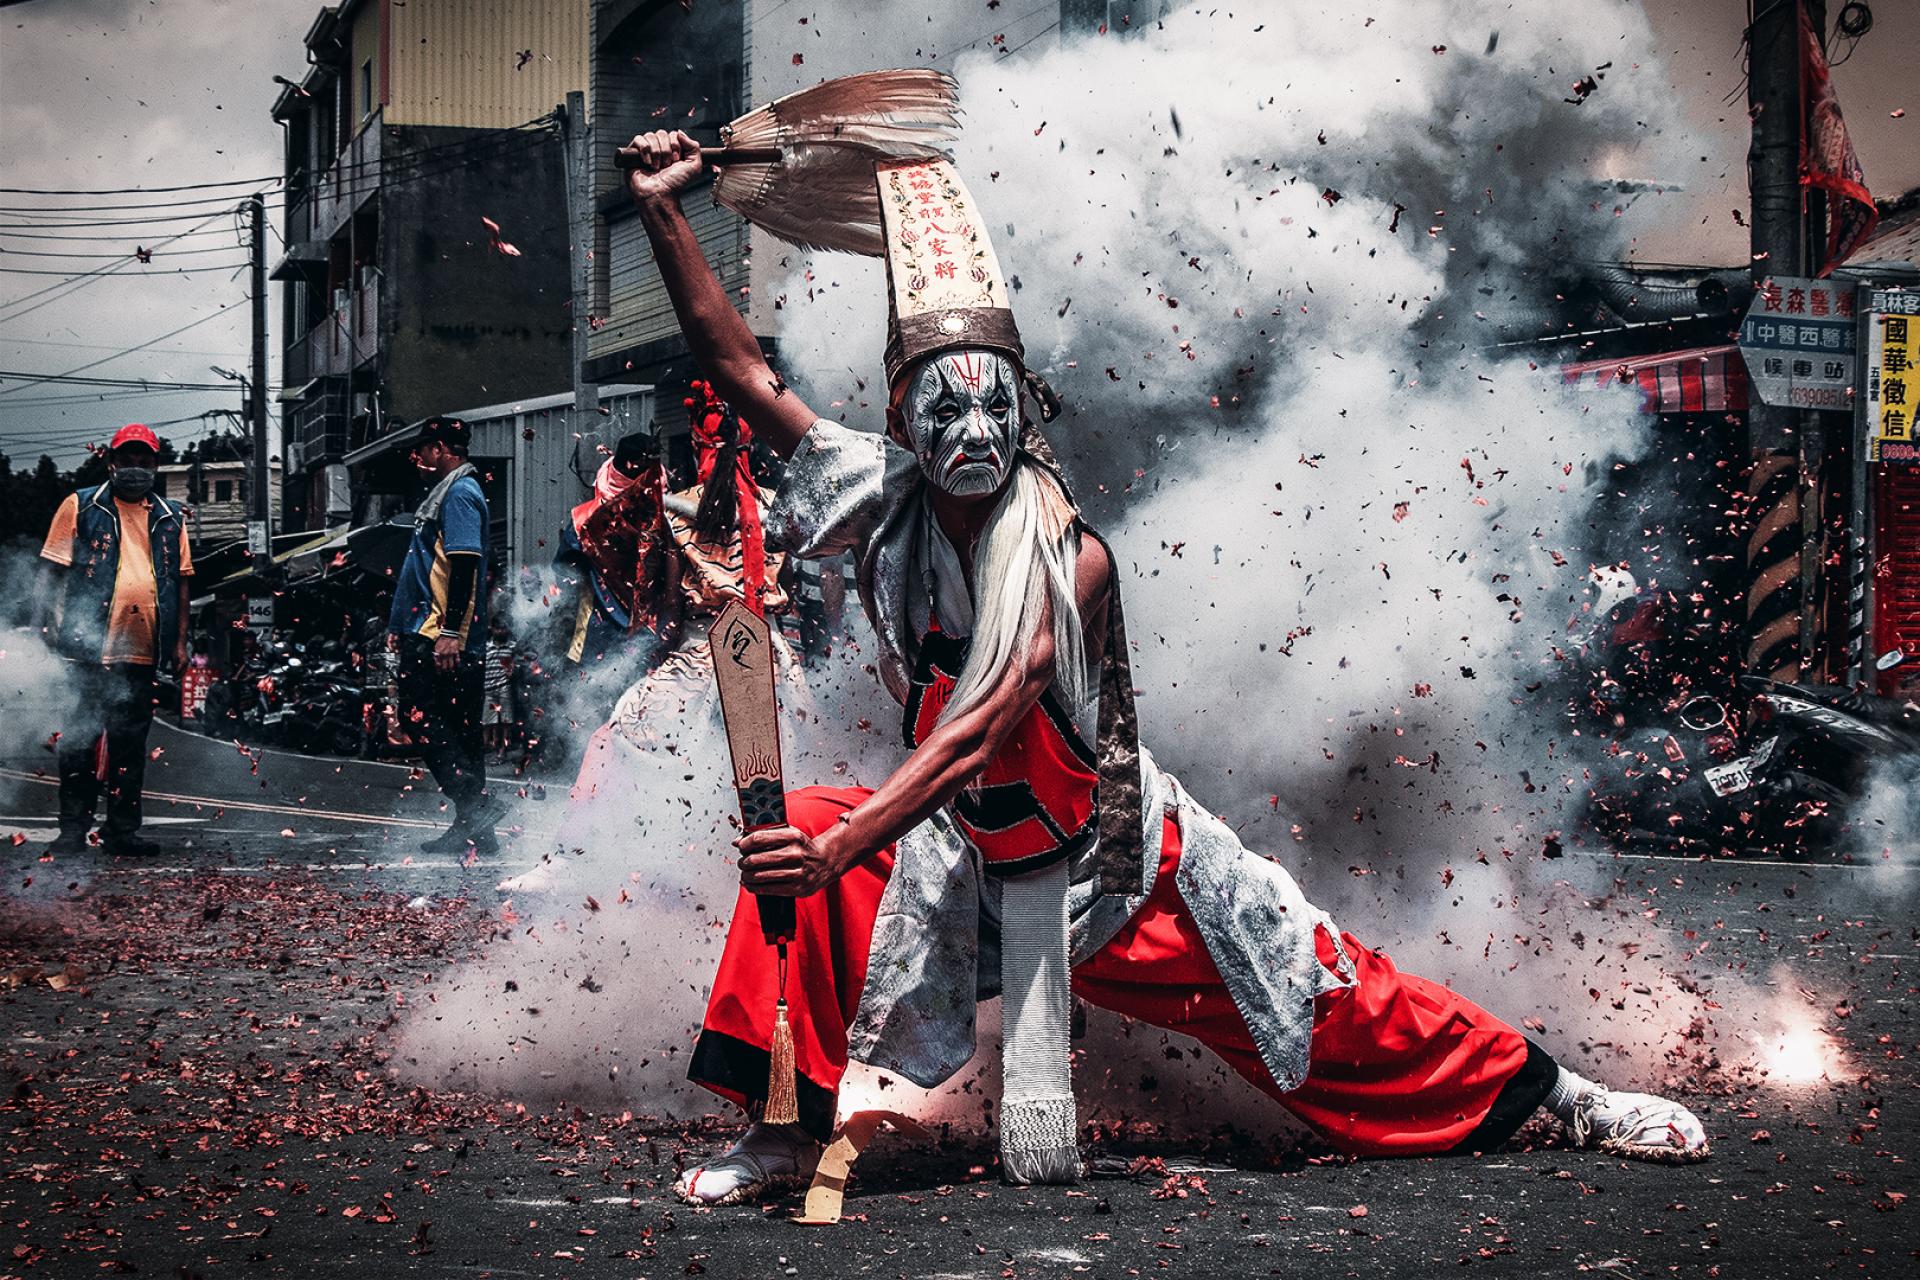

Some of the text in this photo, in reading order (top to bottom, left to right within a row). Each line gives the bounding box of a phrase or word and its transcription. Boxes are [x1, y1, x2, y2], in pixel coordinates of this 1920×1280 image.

[1872, 293, 1920, 313] 員林客
[1764, 358, 1845, 379] 候車站
[1883, 318, 1908, 436] 國華徵信
